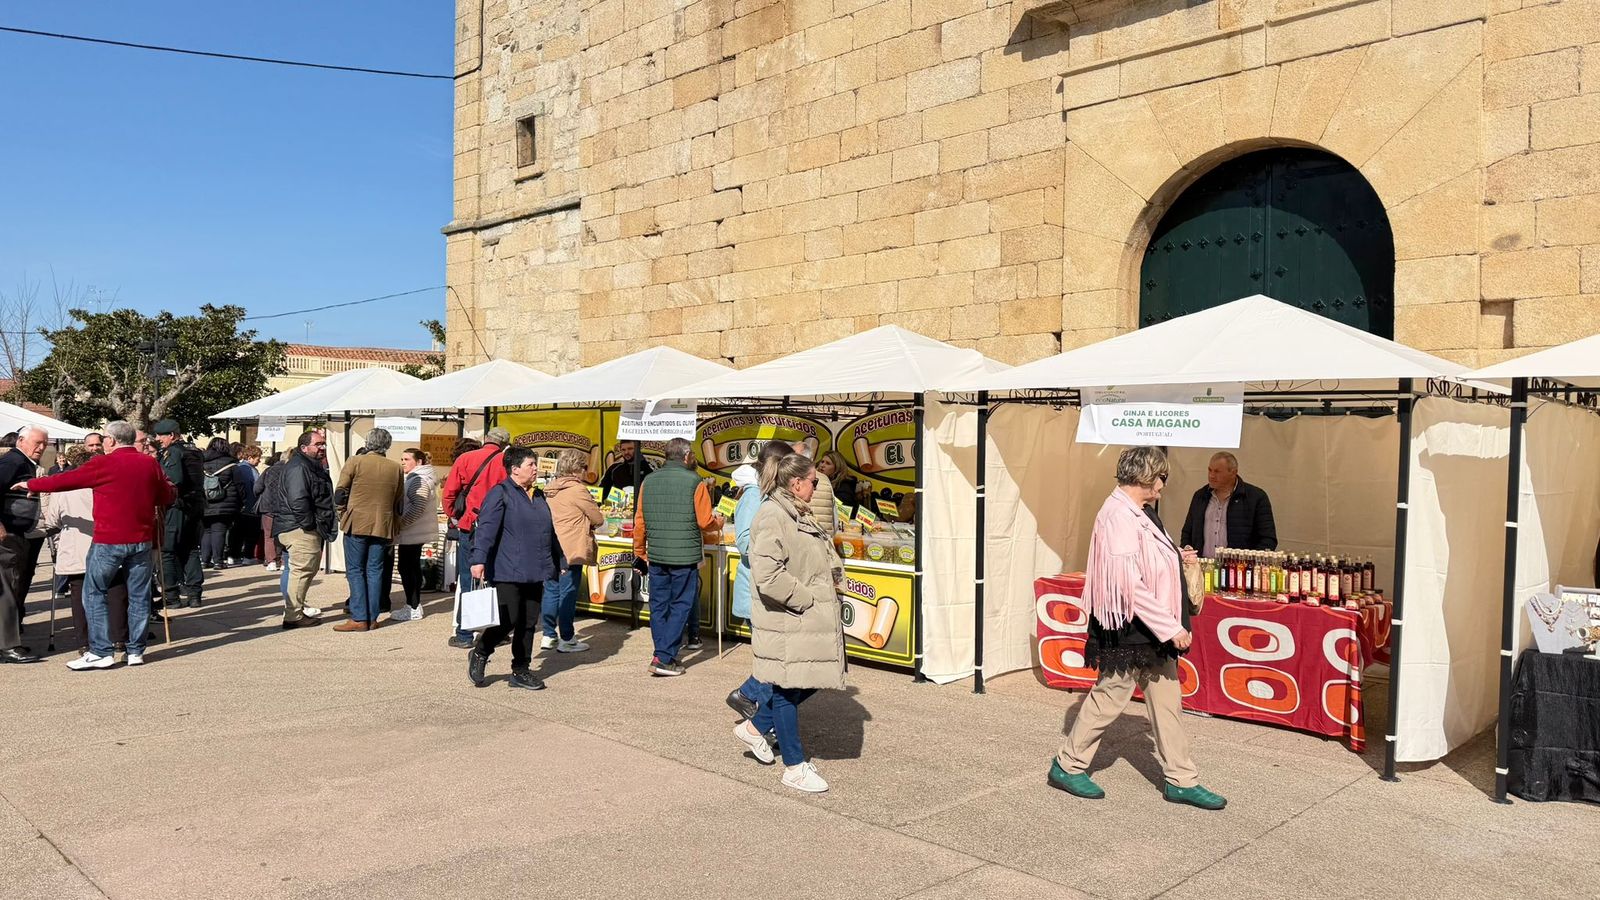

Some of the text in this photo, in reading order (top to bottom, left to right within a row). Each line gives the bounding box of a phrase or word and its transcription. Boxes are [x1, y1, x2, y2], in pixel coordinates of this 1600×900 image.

[854, 410, 913, 437] Aceitunas
[1111, 418, 1201, 428] CASA MAGANO
